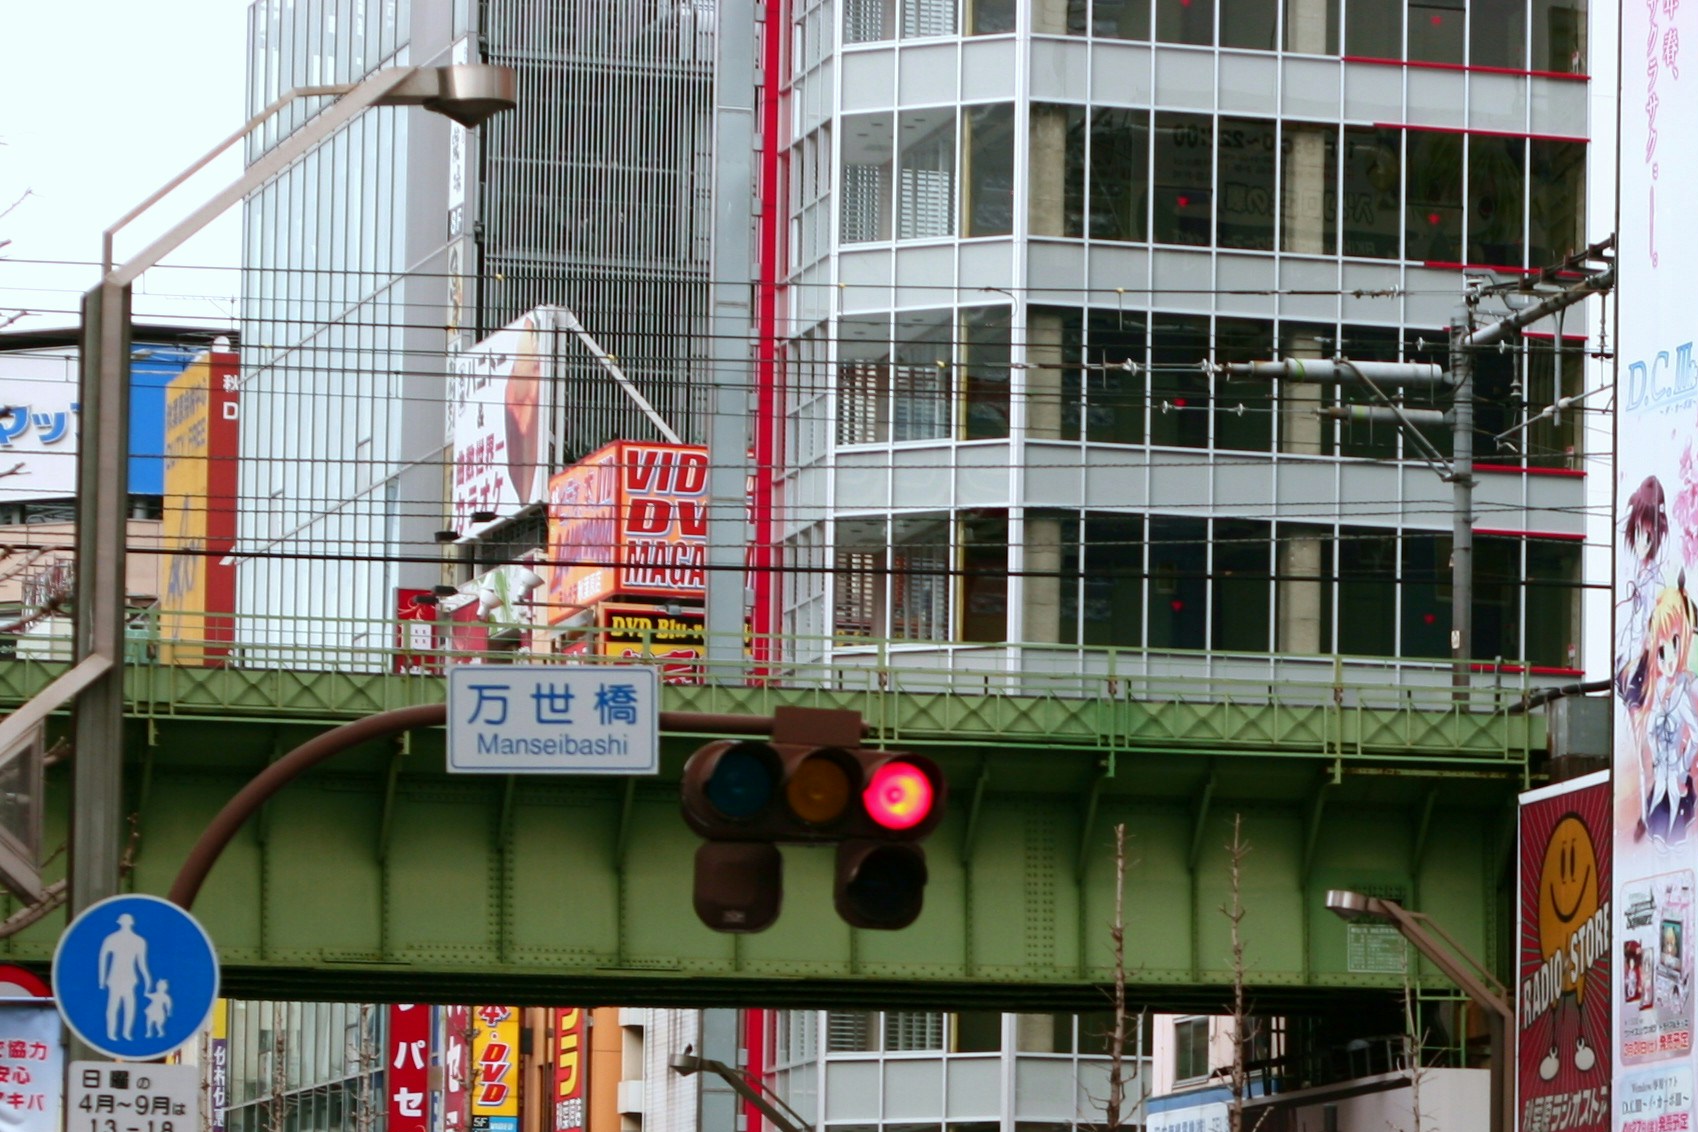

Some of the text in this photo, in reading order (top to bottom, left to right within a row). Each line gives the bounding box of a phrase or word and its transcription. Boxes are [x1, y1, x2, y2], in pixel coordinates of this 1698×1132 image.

[626, 499, 707, 536] DV
[467, 684, 639, 726] 万世橋
[476, 732, 629, 757] Manseibashi
[1521, 903, 1609, 1030] RADIO STORE
[82, 1070, 151, 1090] 日曜の
